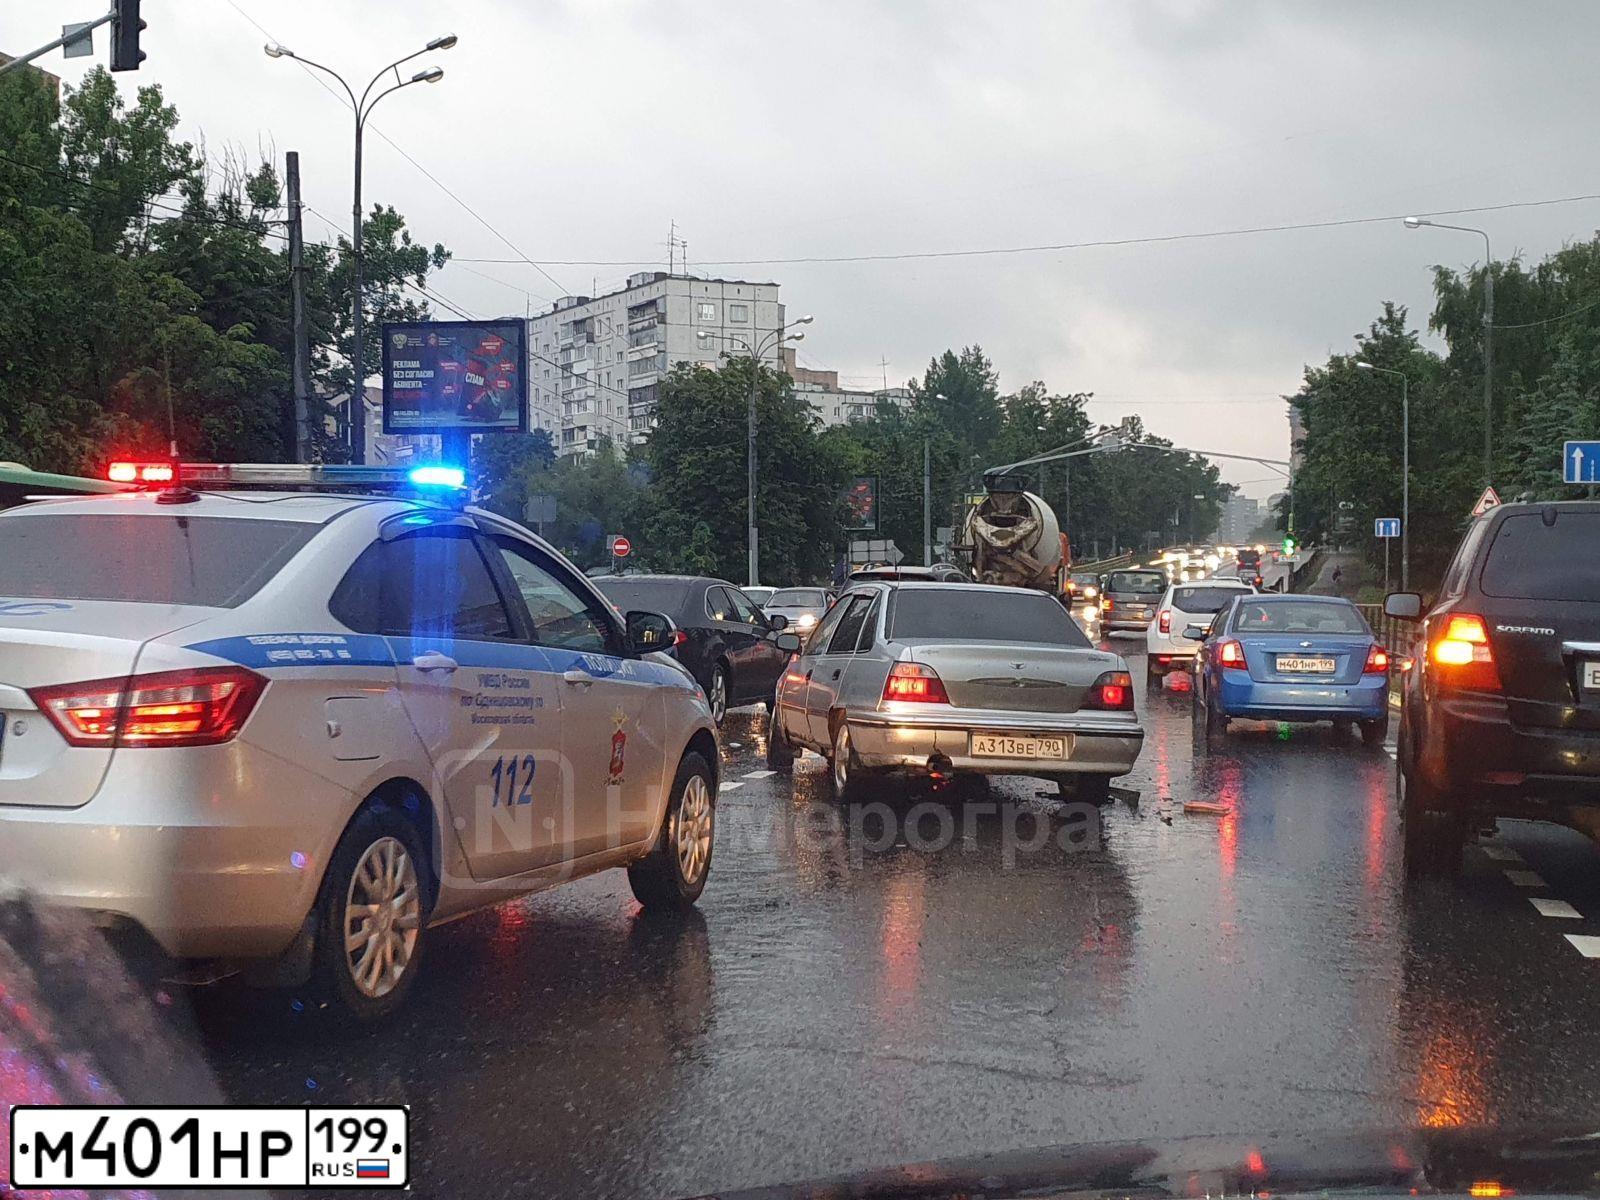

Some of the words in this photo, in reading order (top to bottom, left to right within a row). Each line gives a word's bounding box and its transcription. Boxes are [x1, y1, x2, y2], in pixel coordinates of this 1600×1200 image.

[465, 372, 485, 386] СПАМ
[1496, 625, 1556, 636] SORENTO
[1280, 660, 1317, 671] М401НР
[1318, 660, 1333, 669] 199
[977, 738, 1034, 755] А313ВЕ
[1037, 739, 1060, 752] 790
[491, 754, 536, 808] 112
